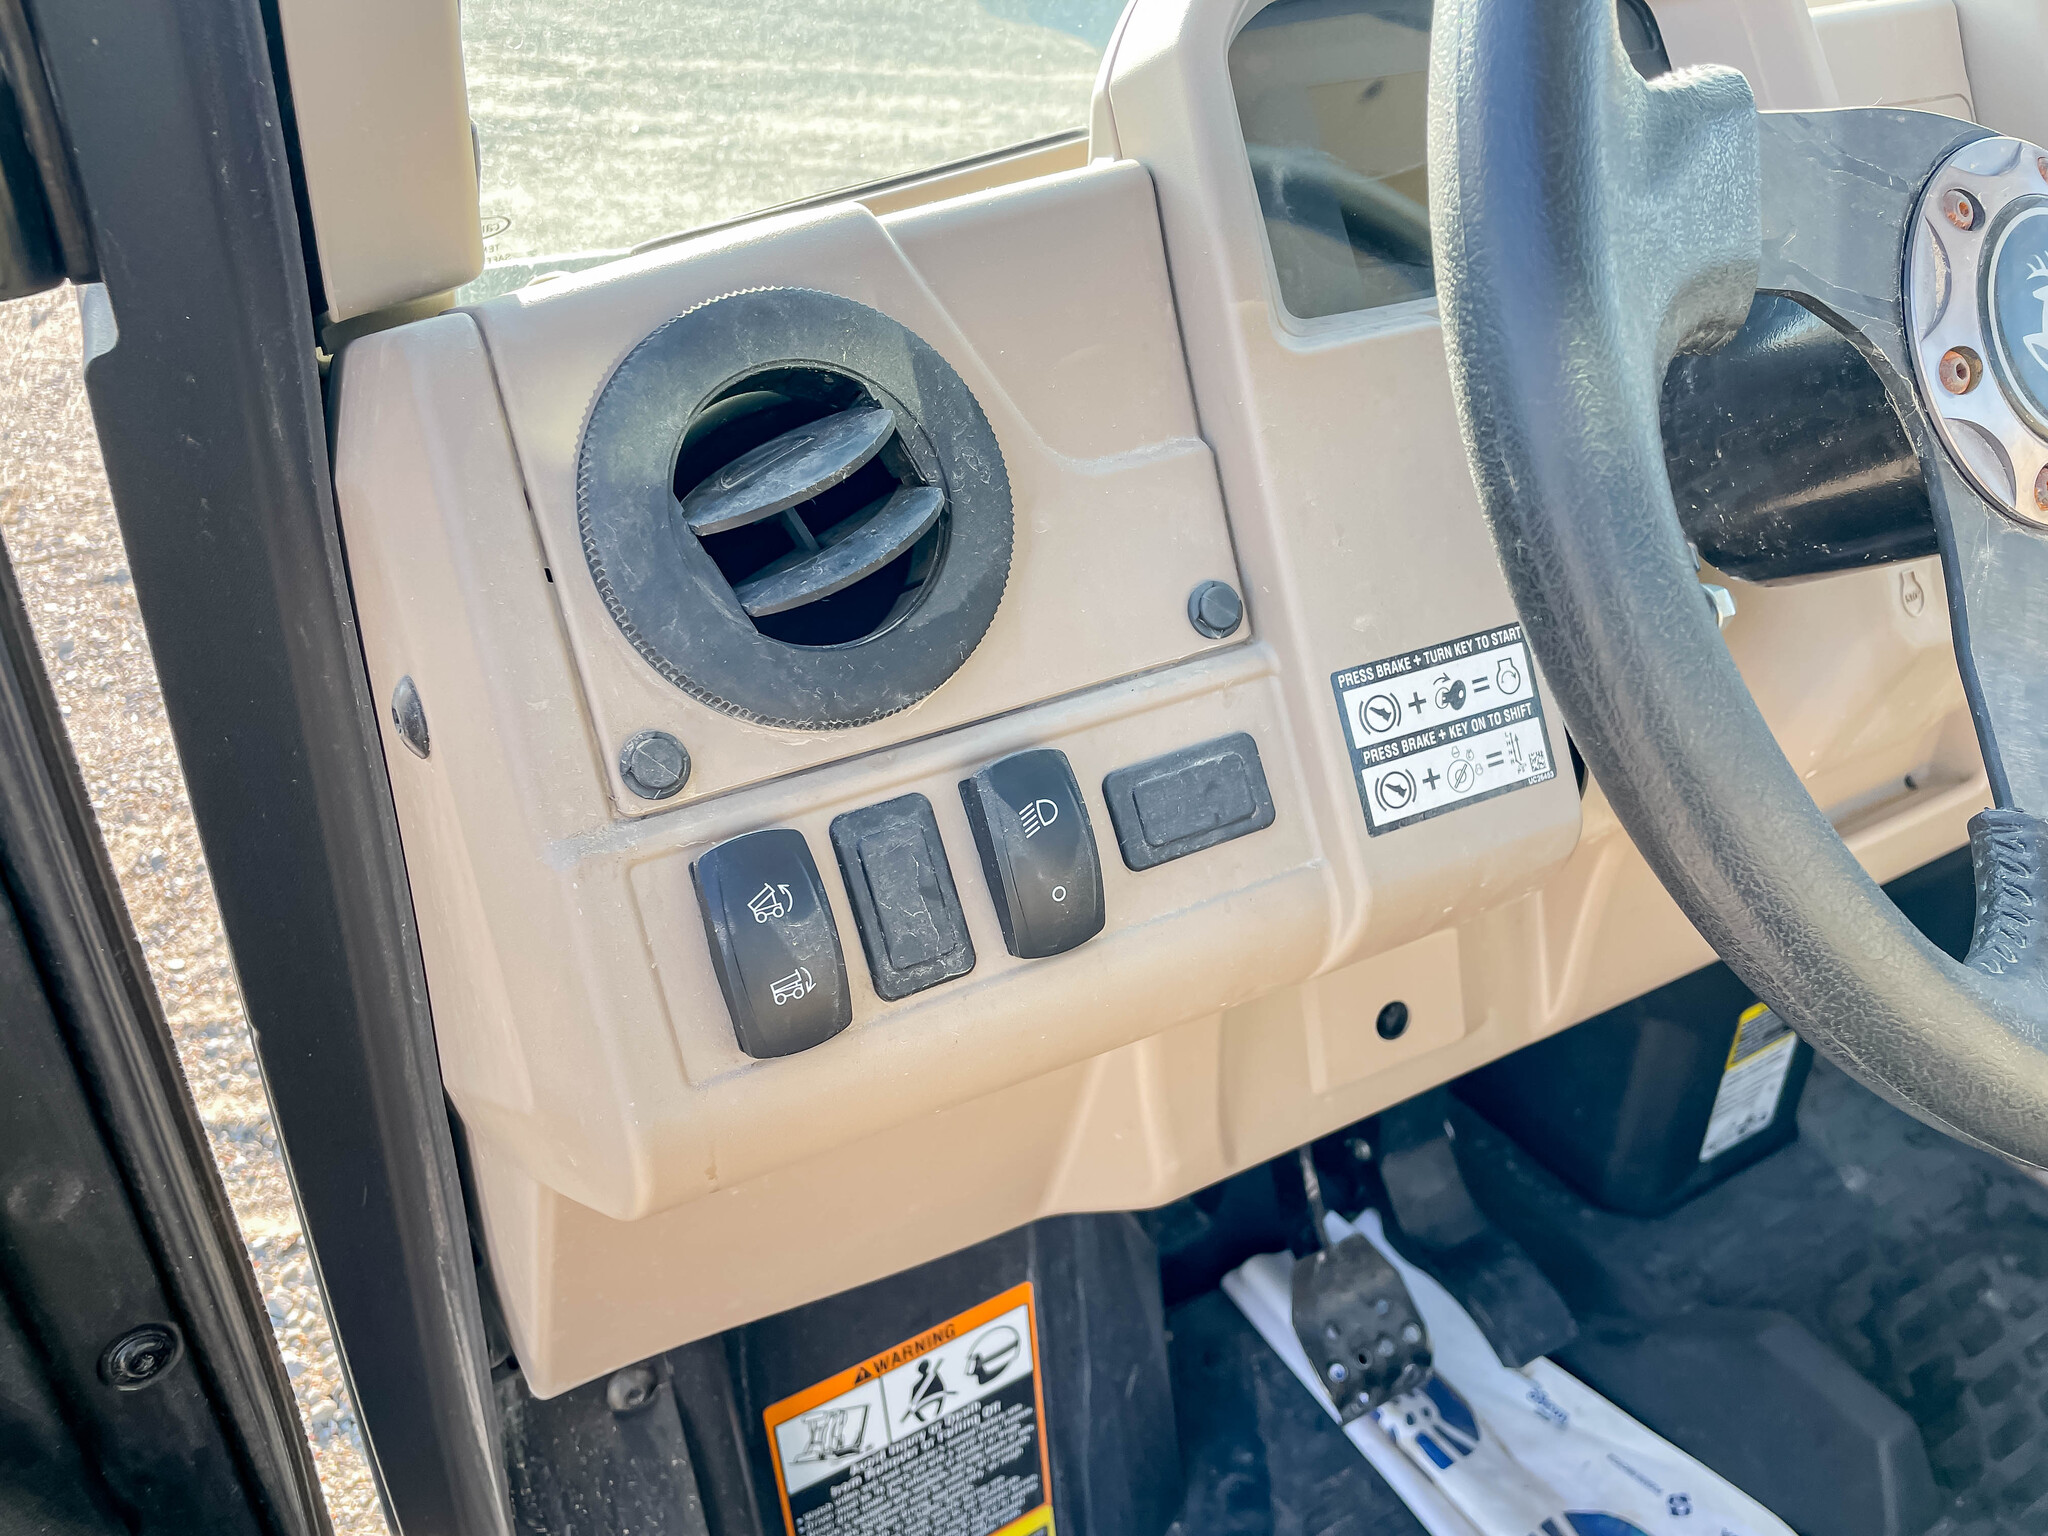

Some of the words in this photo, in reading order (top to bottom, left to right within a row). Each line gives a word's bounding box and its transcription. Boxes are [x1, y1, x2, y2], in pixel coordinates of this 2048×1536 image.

[1337, 667, 1375, 688] PRESS
[1376, 656, 1412, 677] BRAKE
[1423, 645, 1453, 665] TURN
[1454, 640, 1473, 657] KEY
[1475, 635, 1489, 650] TO
[1491, 626, 1522, 646] START
[1362, 743, 1400, 765] PRESS
[1401, 732, 1437, 753] BRAKE
[1448, 722, 1468, 740] KEY
[1470, 717, 1486, 733] ON
[1487, 712, 1501, 727] TO
[1504, 702, 1532, 722] SHIFT
[873, 1323, 956, 1373] WARNING
